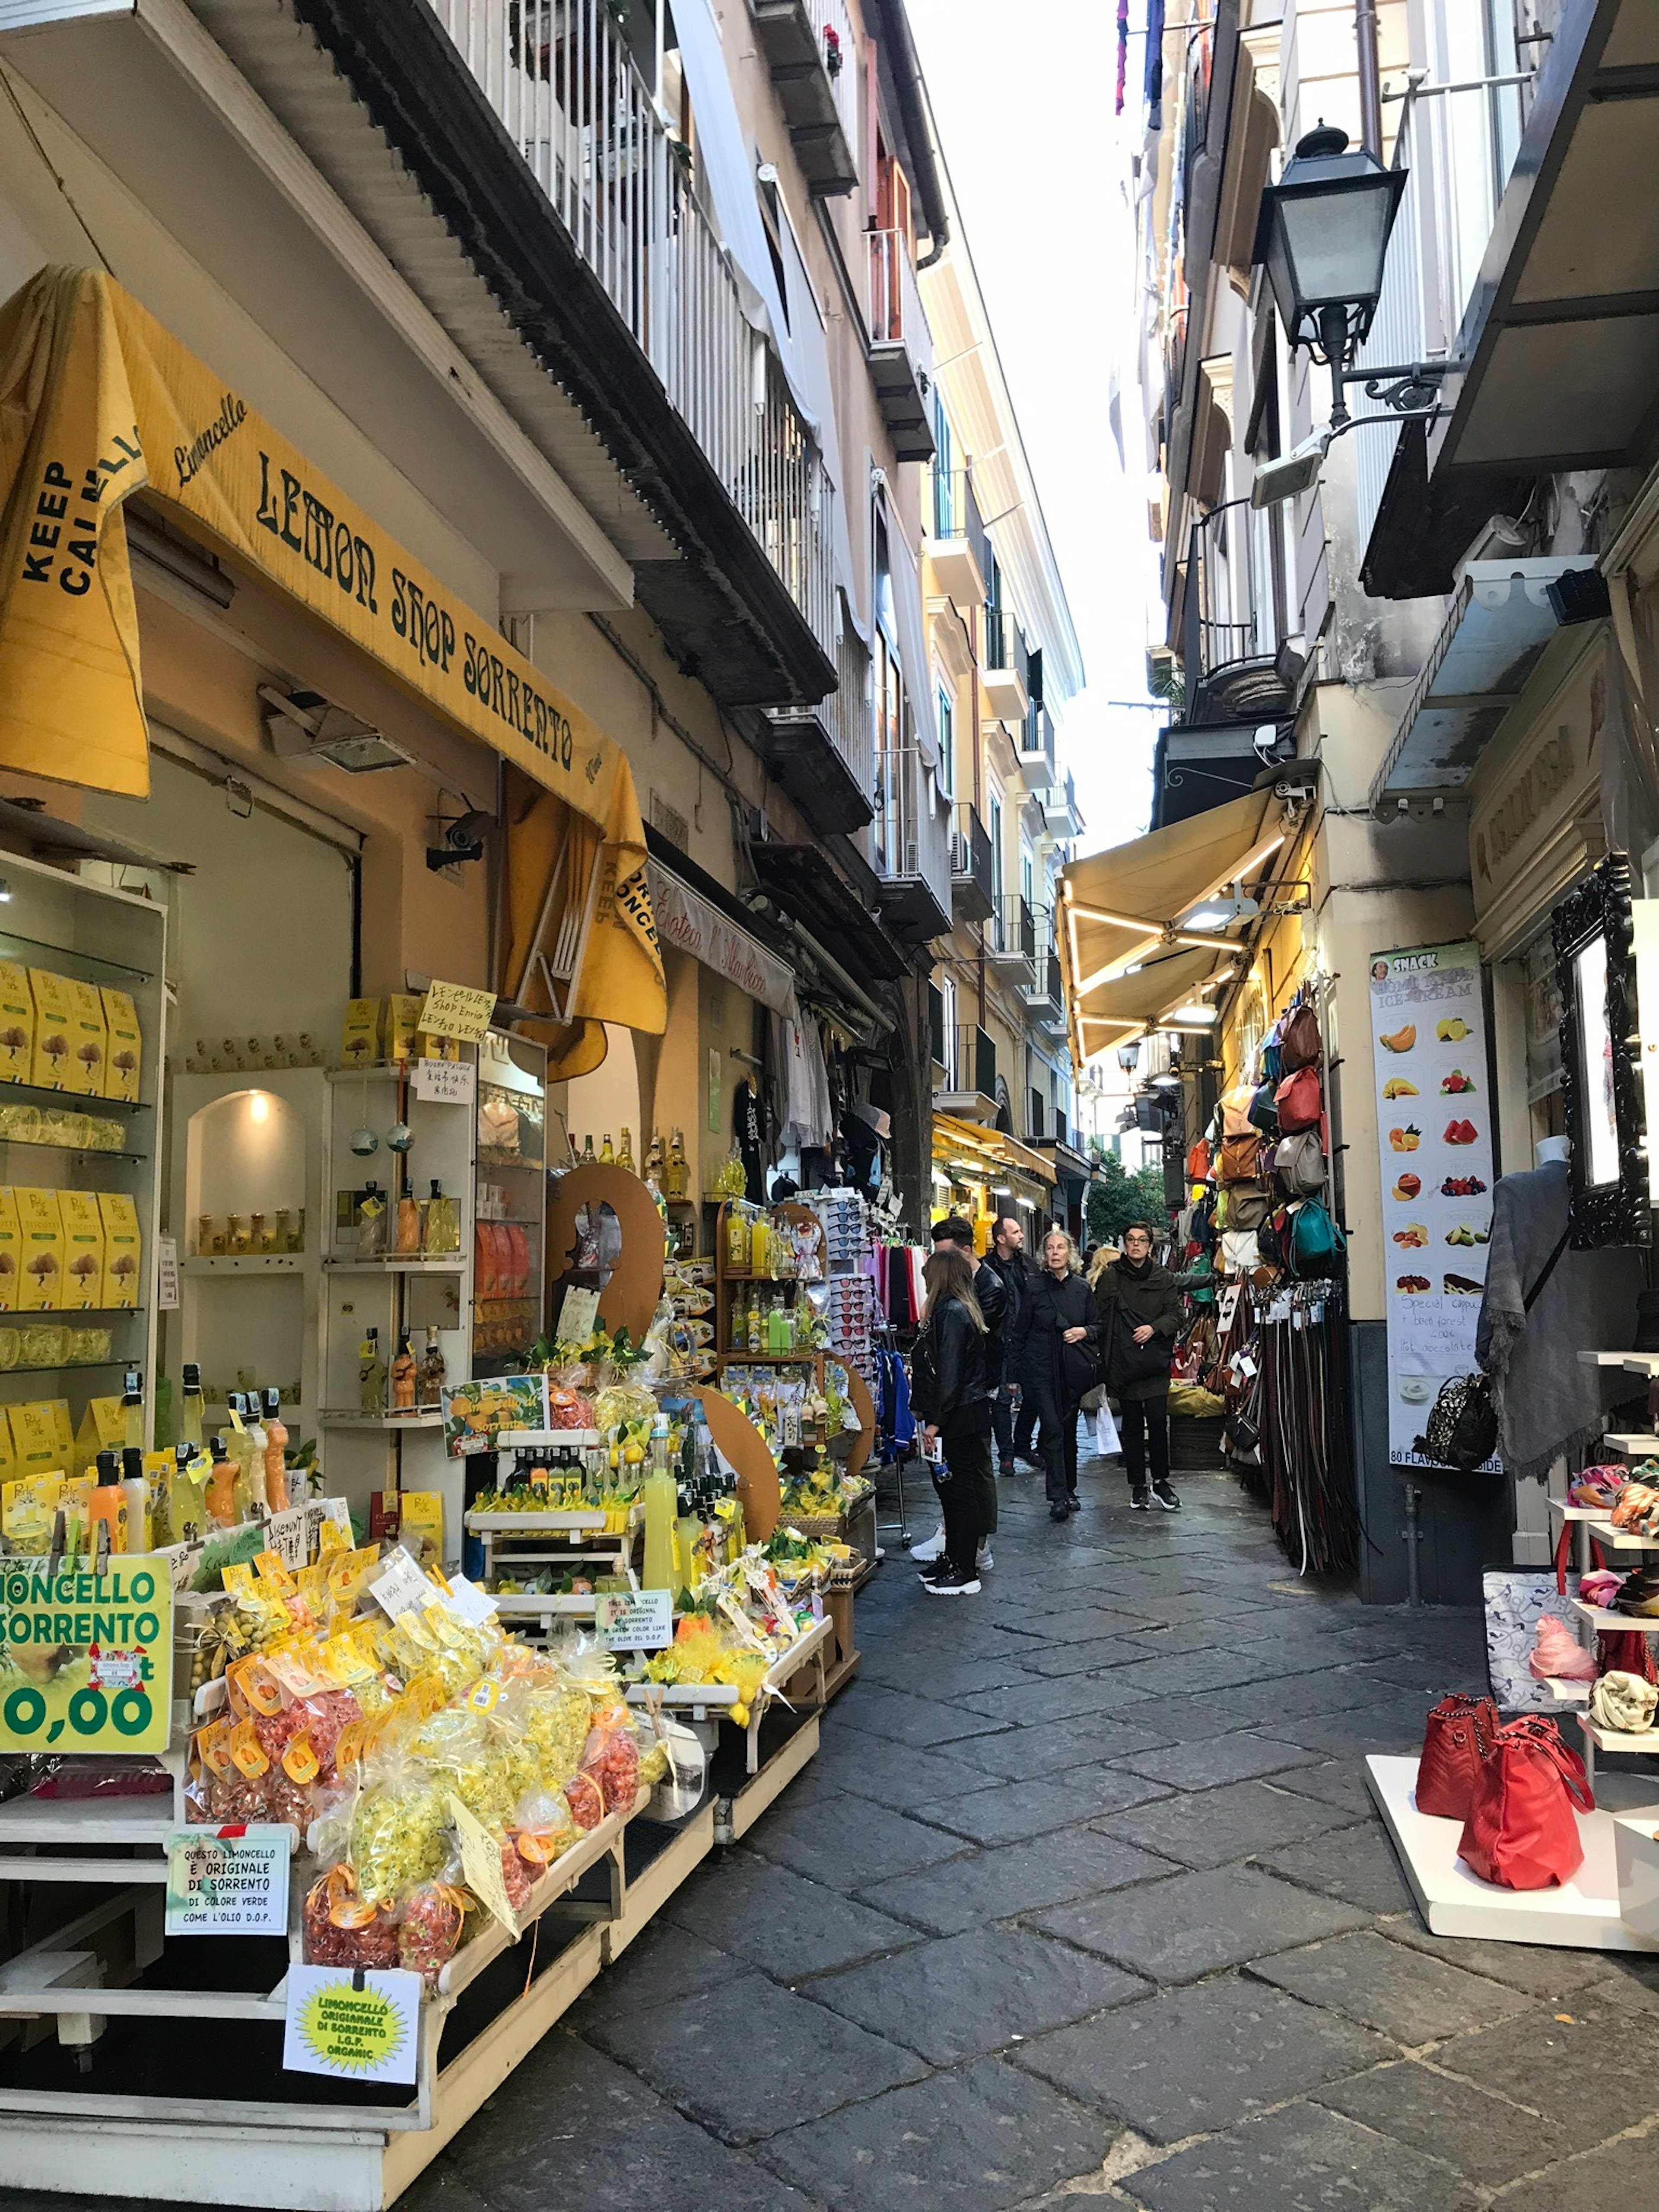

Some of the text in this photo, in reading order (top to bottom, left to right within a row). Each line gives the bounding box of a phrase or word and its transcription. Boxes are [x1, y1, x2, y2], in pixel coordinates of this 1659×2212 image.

[173, 391, 248, 488] Limoncello
[22, 461, 73, 582] KEEP
[256, 451, 572, 770] LEMON SHOP SORRENTO
[1394, 952, 1439, 972] SNACK
[1378, 968, 1474, 994] HOME MADE
[1402, 1295, 1443, 1315] Special
[1437, 1315, 1467, 1327] forest
[524, 1395, 537, 1407] di
[474, 1420, 525, 1433] Sorrento
[1391, 1450, 1402, 1463] 80
[0, 1572, 155, 1604] ONCELLO
[184, 1850, 275, 1861] QUESTO LIMONCELLO
[190, 1861, 270, 1875] È ORIGINALE
[188, 1878, 270, 1891] DI SORRENTO
[189, 1897, 268, 1907] DI COLORE VERDE
[183, 1913, 271, 1922] COME L'OLIO D.O.P.
[318, 1997, 388, 2016] LIMONCELLO
[317, 2021, 386, 2038] DI SORRENTO
[337, 2035, 364, 2047] I.G.P.
[327, 2044, 373, 2059] ORGANIC
